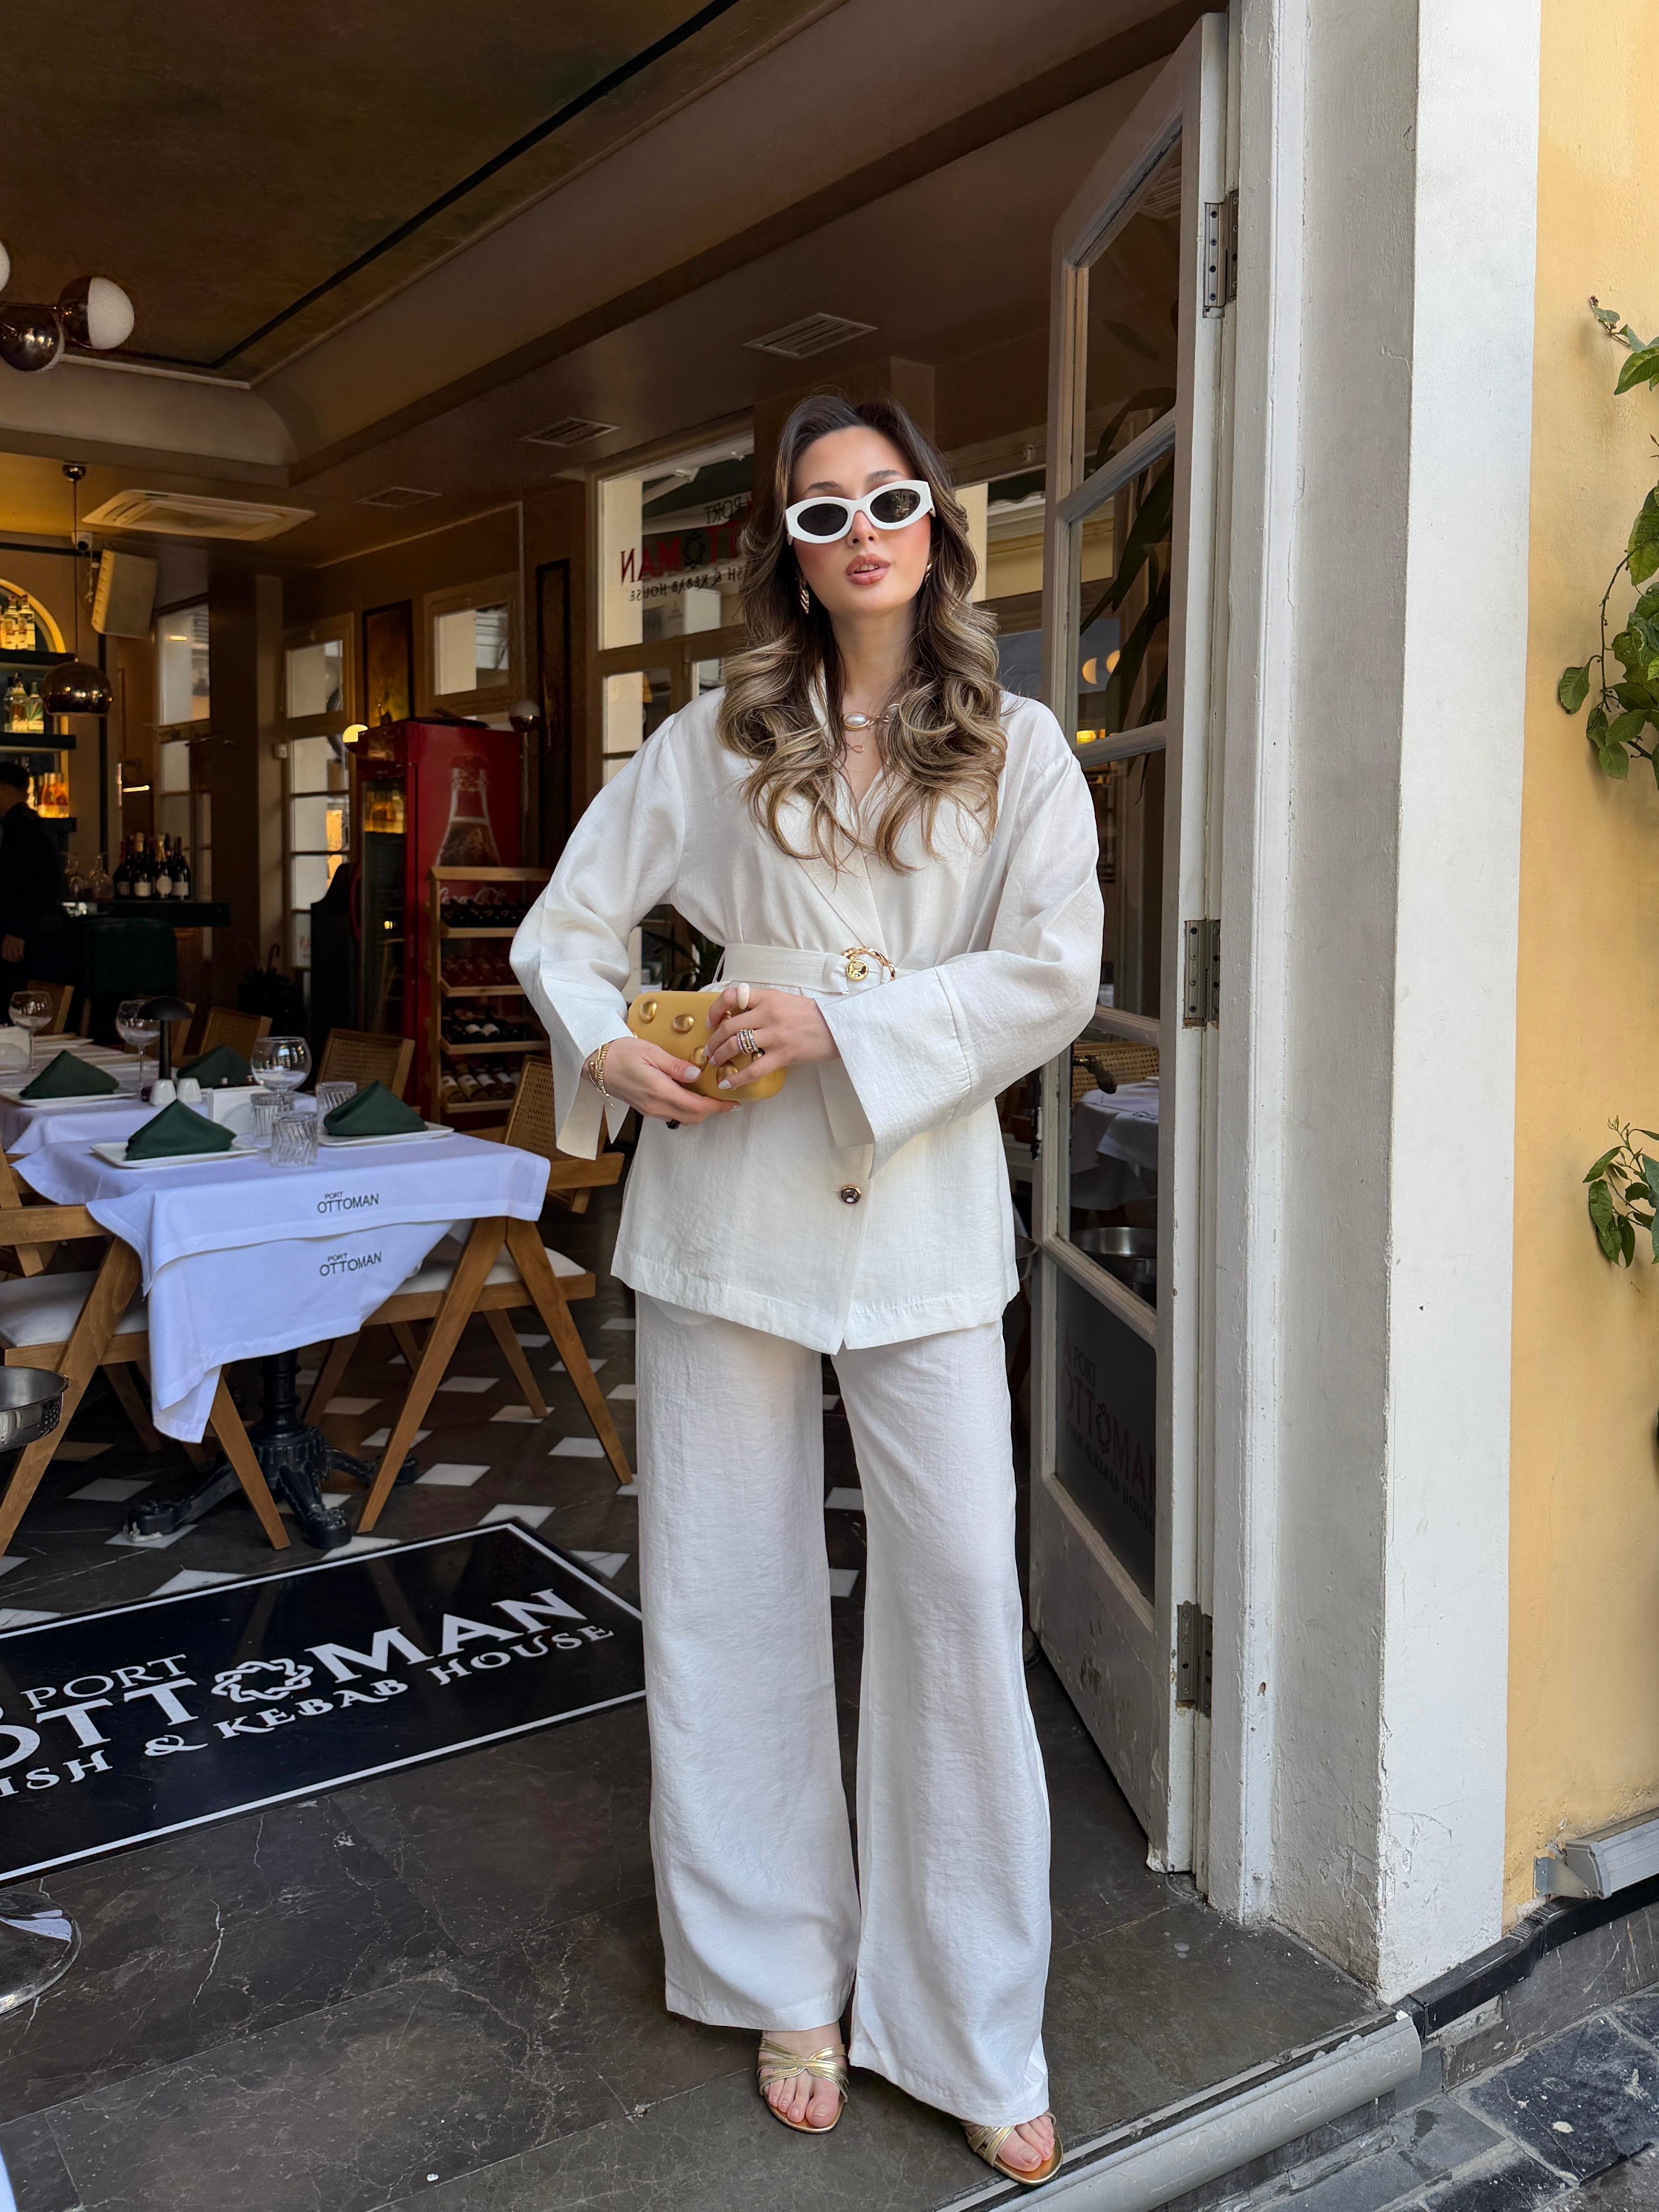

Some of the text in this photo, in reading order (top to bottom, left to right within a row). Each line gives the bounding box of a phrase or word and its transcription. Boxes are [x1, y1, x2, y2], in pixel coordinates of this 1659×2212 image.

[317, 1193, 379, 1213] OTTOMAN
[325, 1191, 343, 1200] PORT
[320, 1251, 382, 1276] OTTOMAN
[328, 1253, 348, 1262] PORT
[20, 1654, 187, 1710] PORT
[144, 1734, 209, 1757] &
[214, 1678, 409, 1739] KEBAB
[427, 1625, 615, 1686] HOUSE
